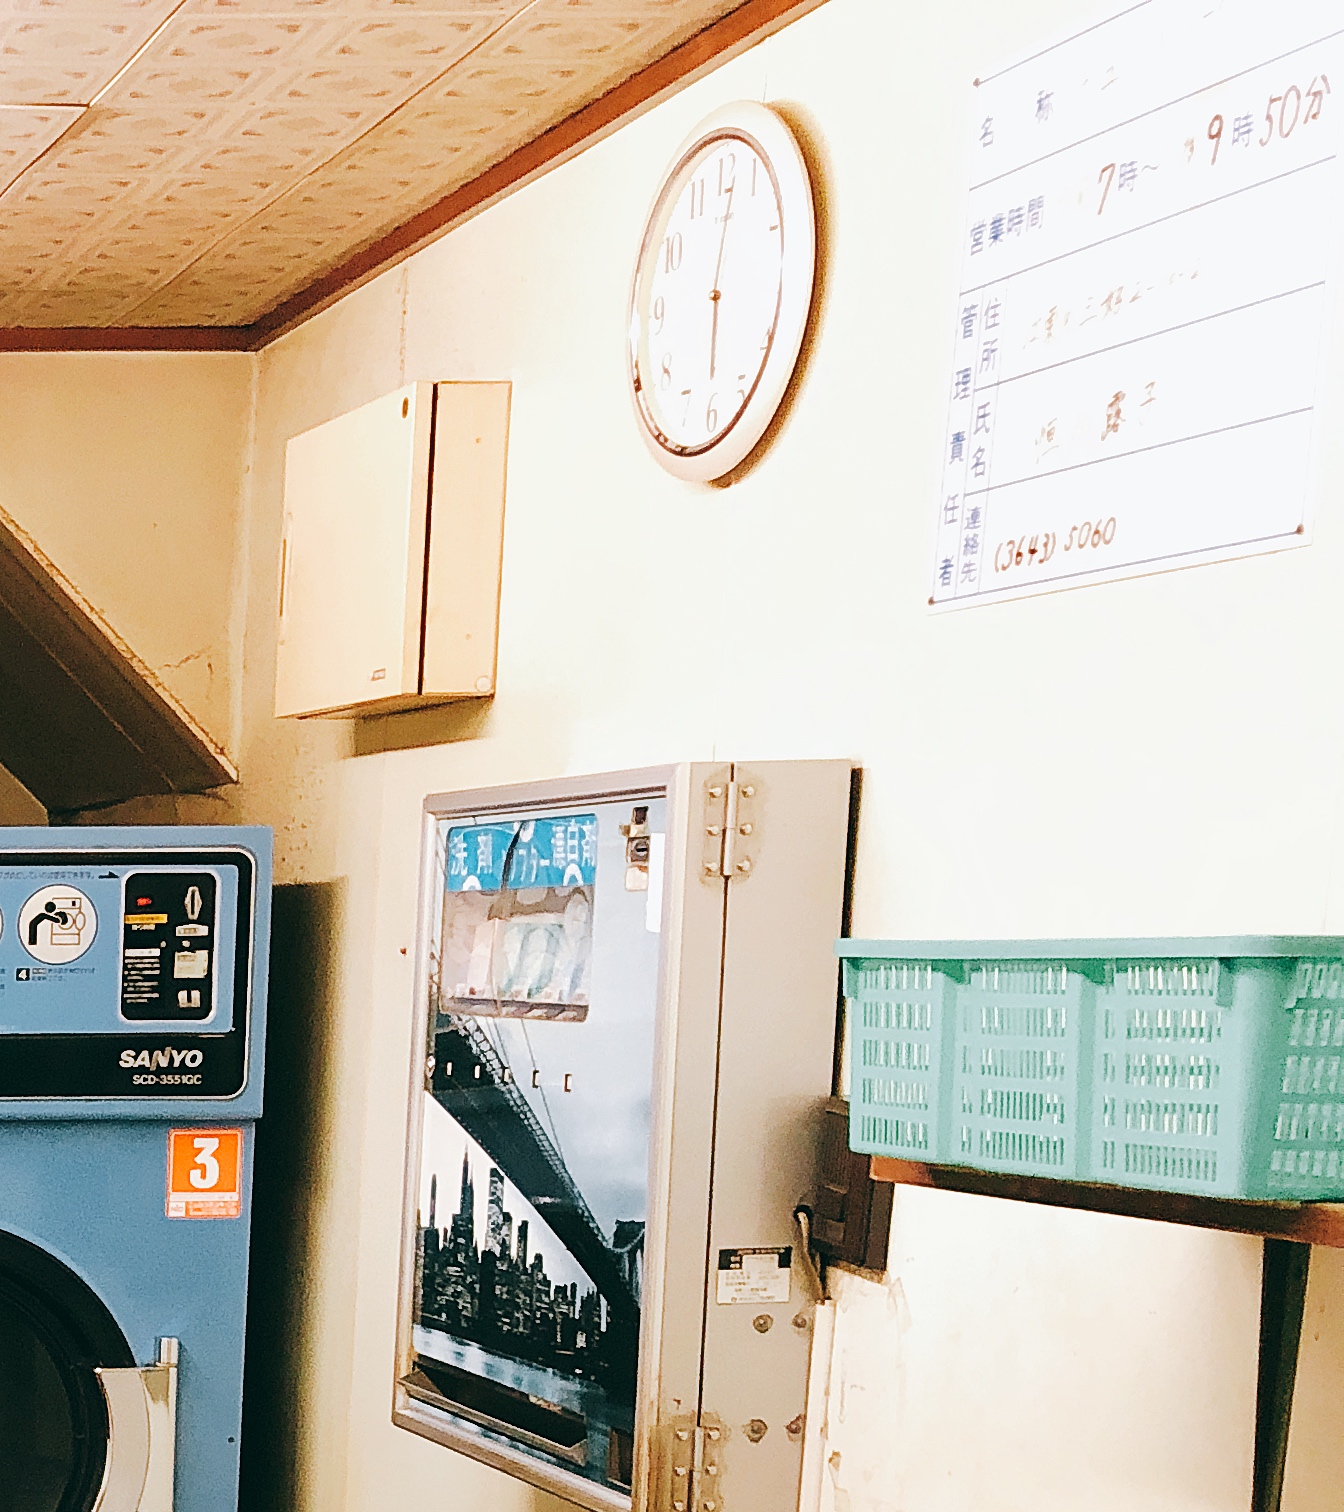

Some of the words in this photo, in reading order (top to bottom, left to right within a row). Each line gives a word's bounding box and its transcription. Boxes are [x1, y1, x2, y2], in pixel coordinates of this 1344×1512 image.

[689, 178, 706, 220] 11
[969, 194, 1046, 256] 営業時間
[663, 231, 684, 275] 10
[705, 392, 720, 434] 6
[971, 401, 992, 478] 氏名
[1063, 516, 1117, 552] 5060
[118, 1046, 204, 1072] SANYO
[132, 1074, 202, 1085] SCD-3551GC
[189, 1137, 220, 1189] 3
